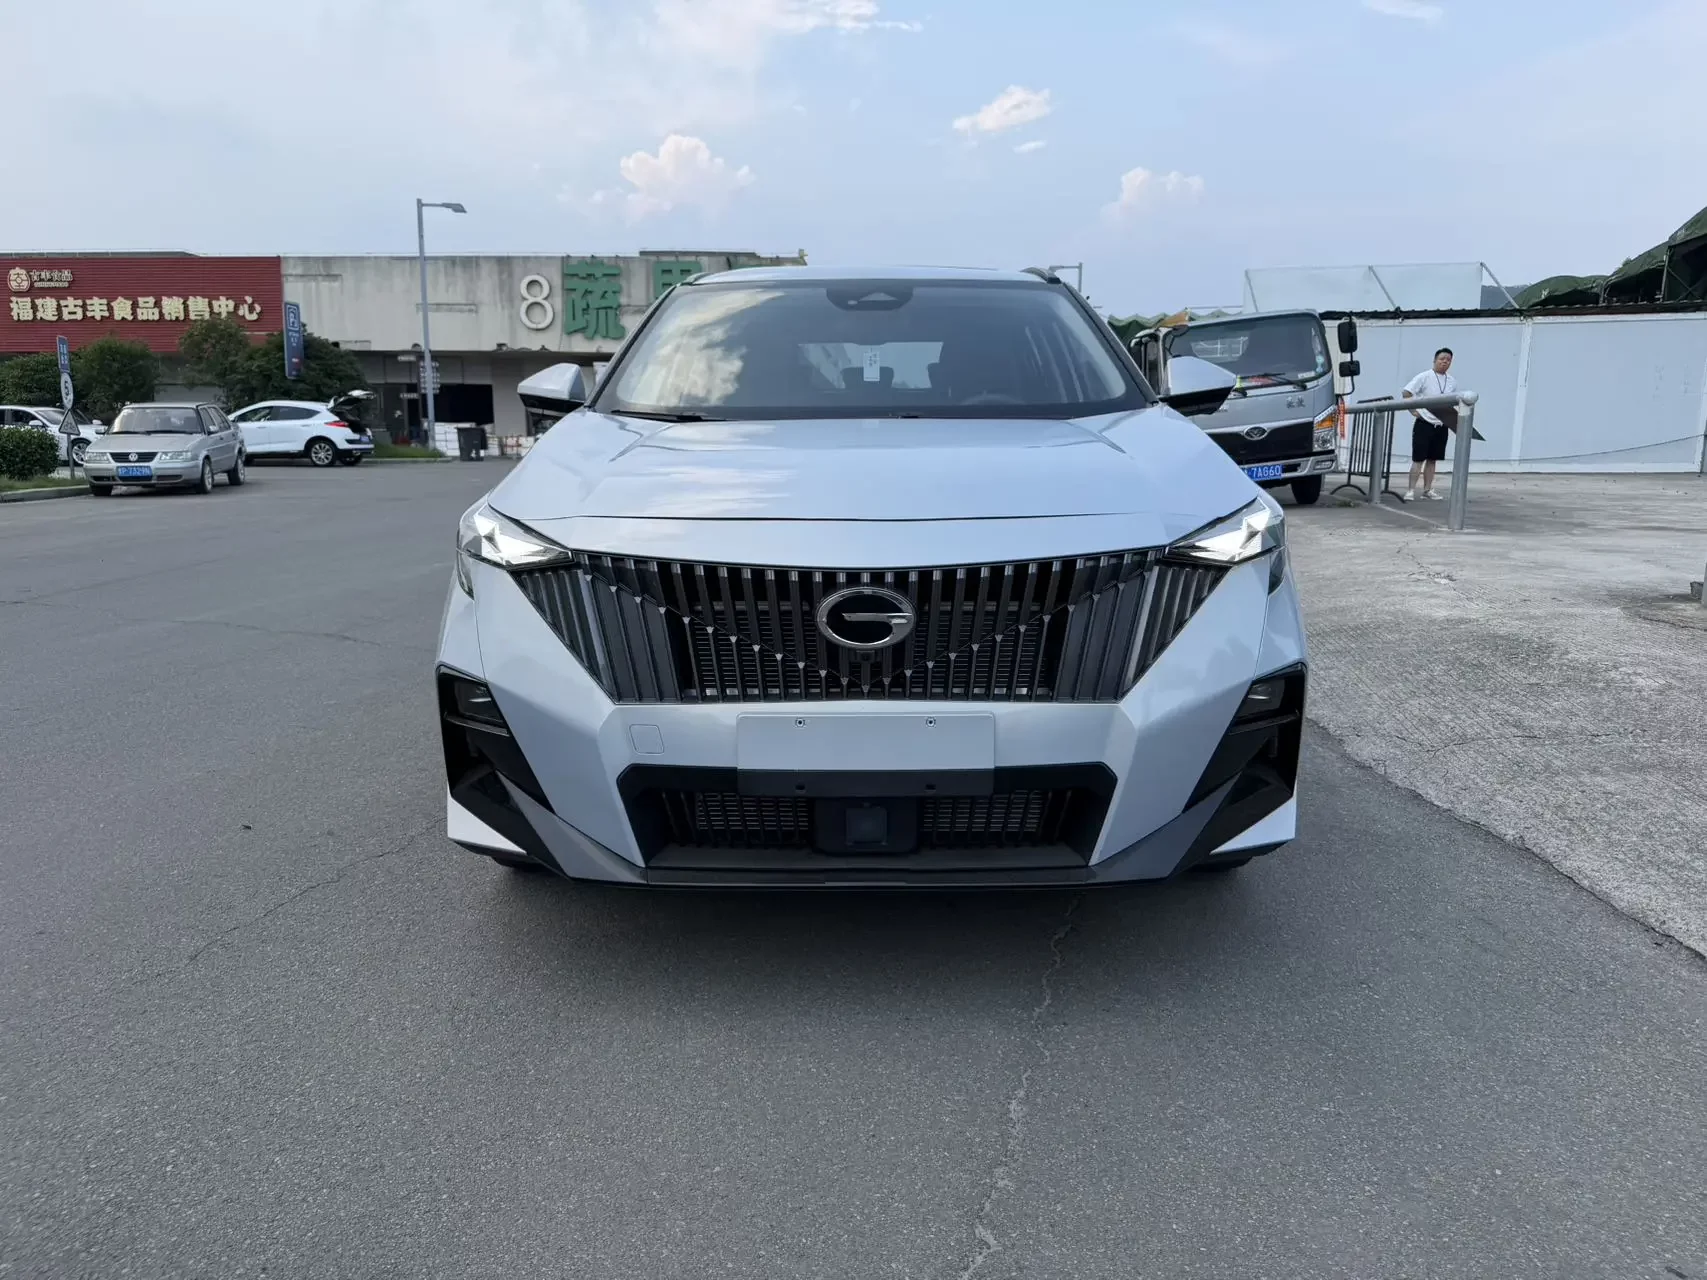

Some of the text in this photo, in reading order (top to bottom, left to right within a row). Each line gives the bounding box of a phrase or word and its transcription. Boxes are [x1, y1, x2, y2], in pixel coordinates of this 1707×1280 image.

[9, 296, 262, 321] 福建古丰食品销售中心
[519, 274, 554, 330] 8
